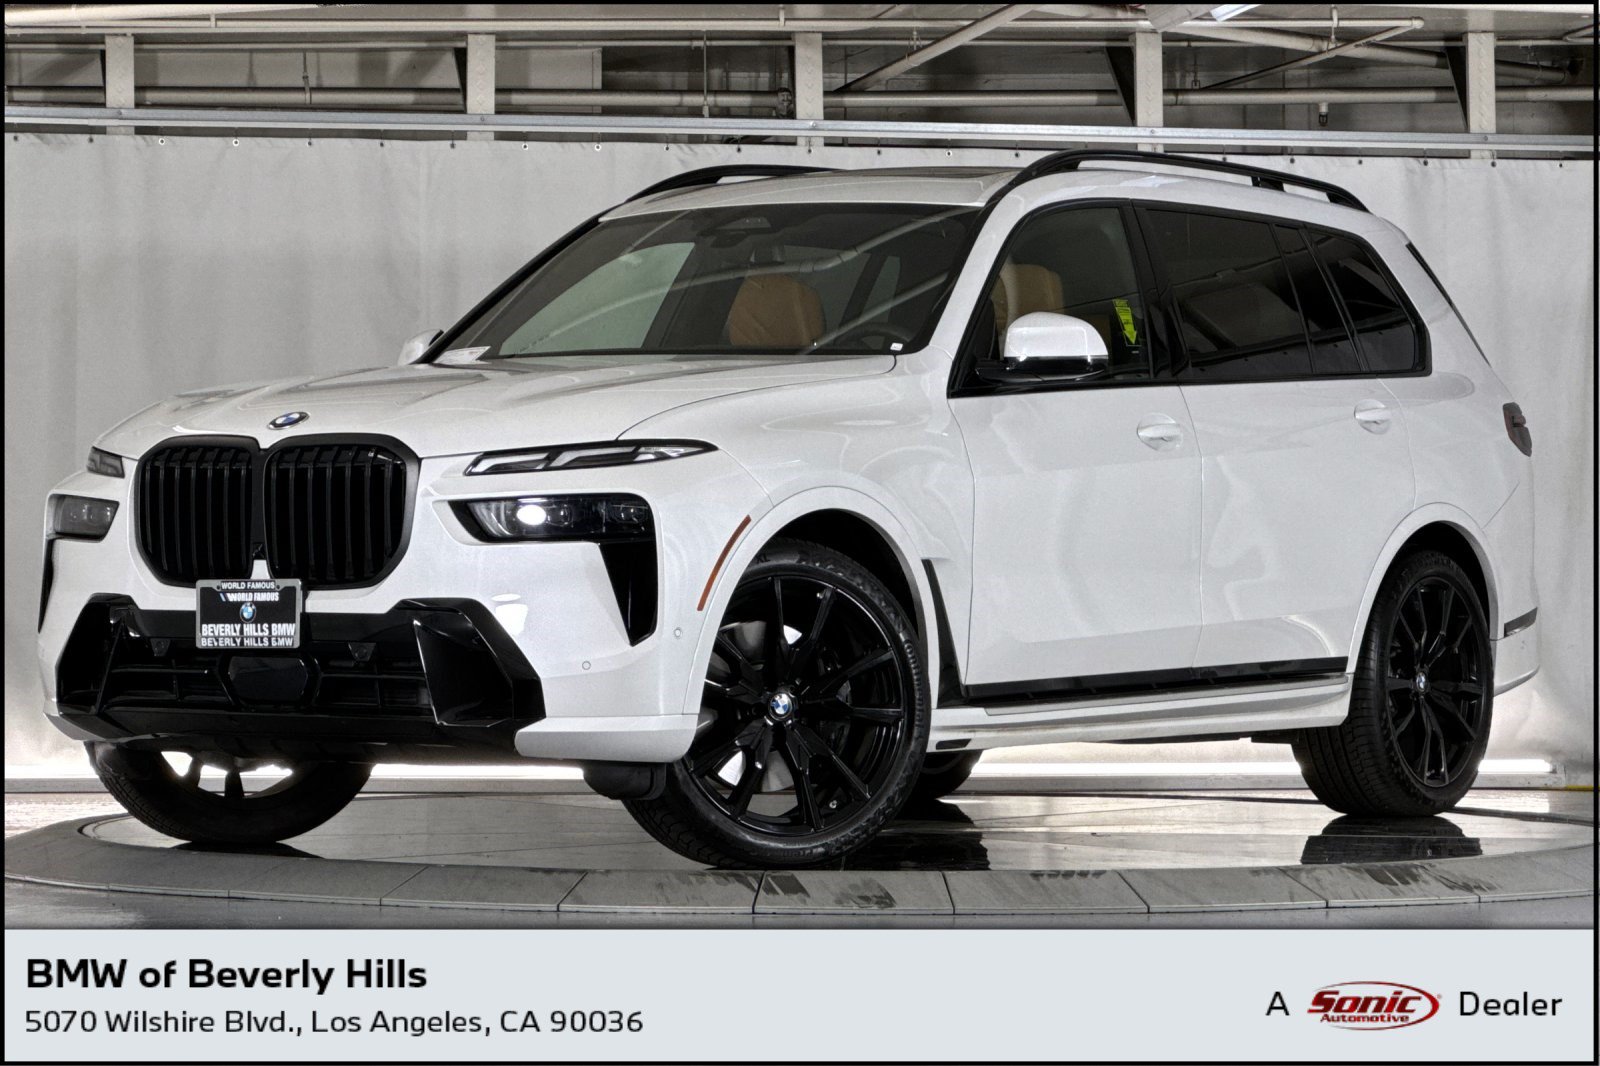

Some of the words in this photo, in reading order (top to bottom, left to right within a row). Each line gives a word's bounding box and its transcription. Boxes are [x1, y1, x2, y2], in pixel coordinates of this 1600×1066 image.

[221, 582, 246, 590] WORLD
[247, 581, 275, 589] FAMOUS
[226, 592, 253, 602] WORLD
[253, 592, 279, 602] FAMOUS
[201, 623, 241, 636] BEVERLY
[243, 623, 269, 636] HILLS
[271, 623, 296, 636] BMW
[201, 637, 241, 646] BEVERLY
[243, 637, 269, 646] HILLS
[271, 637, 294, 646] BMW
